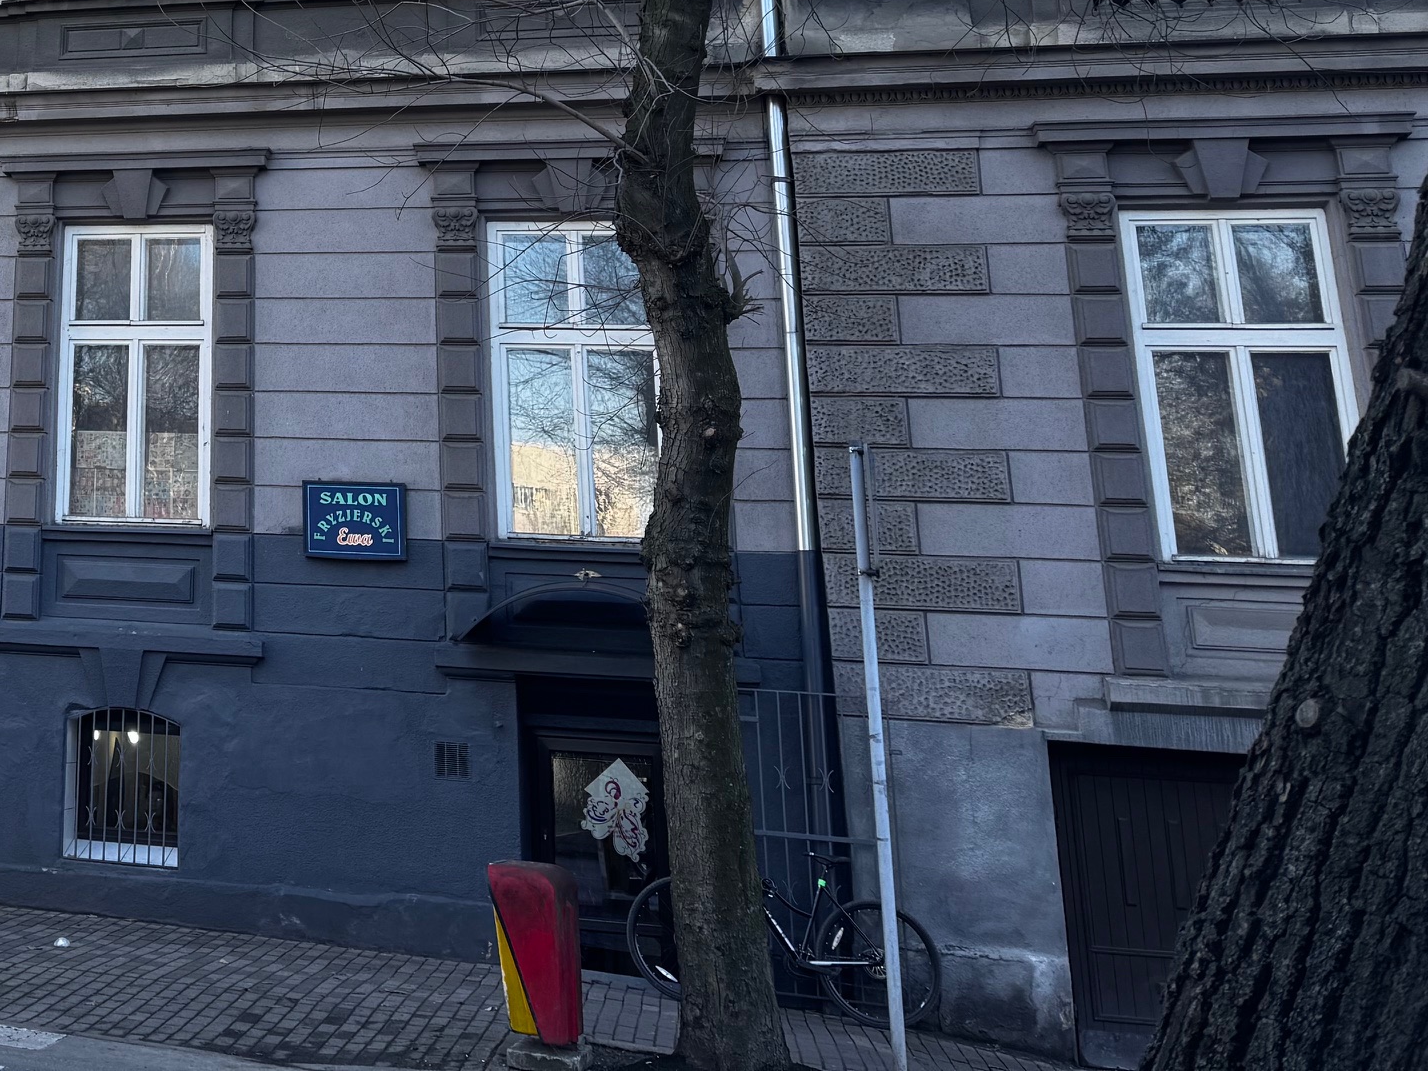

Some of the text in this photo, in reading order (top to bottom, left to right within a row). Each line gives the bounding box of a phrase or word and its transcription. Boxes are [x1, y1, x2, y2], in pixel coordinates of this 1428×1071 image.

[319, 491, 387, 506] SALON
[313, 509, 394, 543] FRYZJERSKI
[336, 527, 373, 546] Ewa
